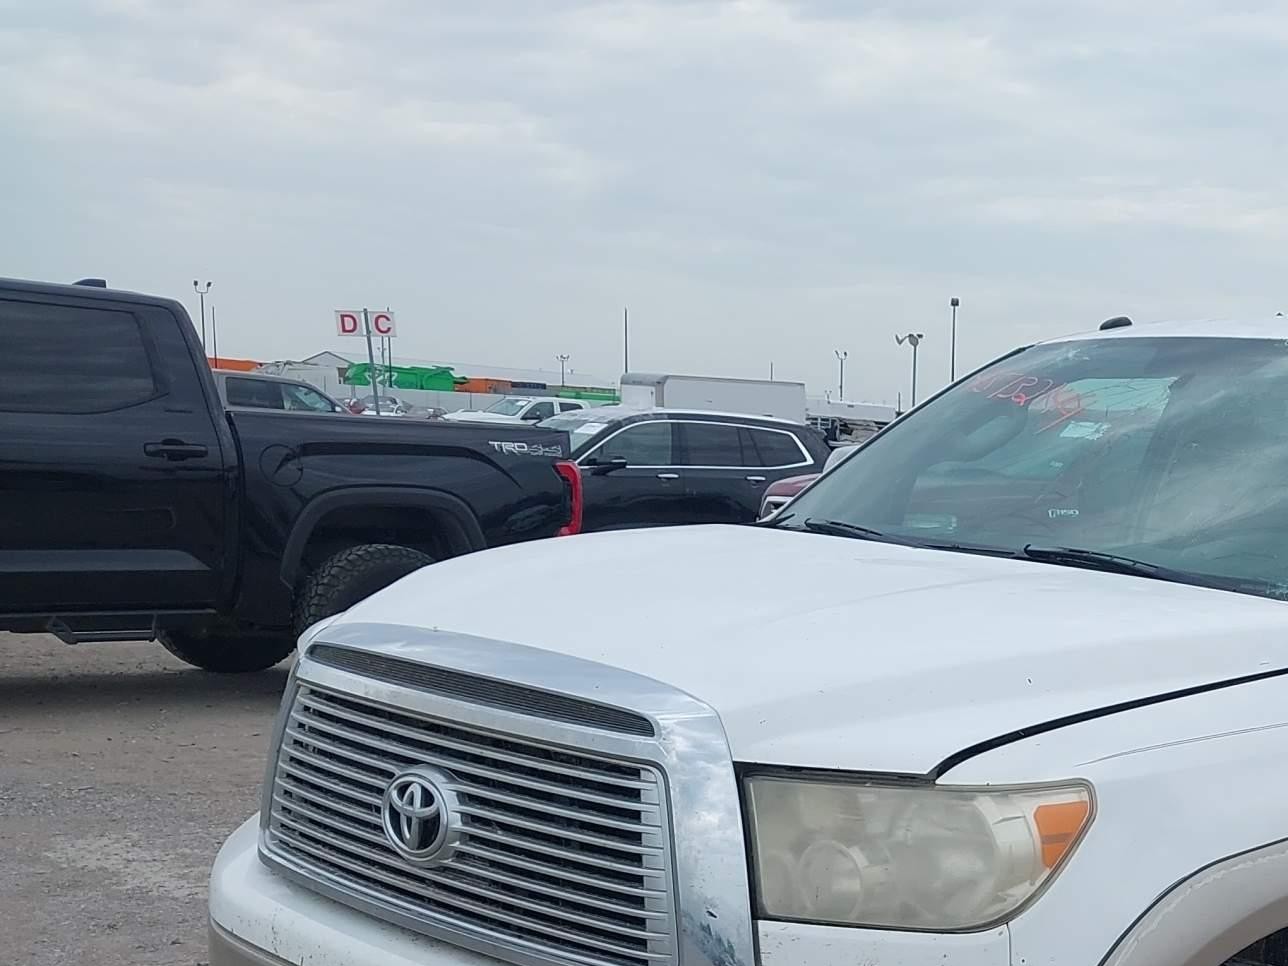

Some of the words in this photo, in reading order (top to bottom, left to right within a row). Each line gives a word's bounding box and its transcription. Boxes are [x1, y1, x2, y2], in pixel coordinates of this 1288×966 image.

[340, 314, 358, 334] D
[374, 314, 392, 334] C
[488, 440, 528, 456] TRD
